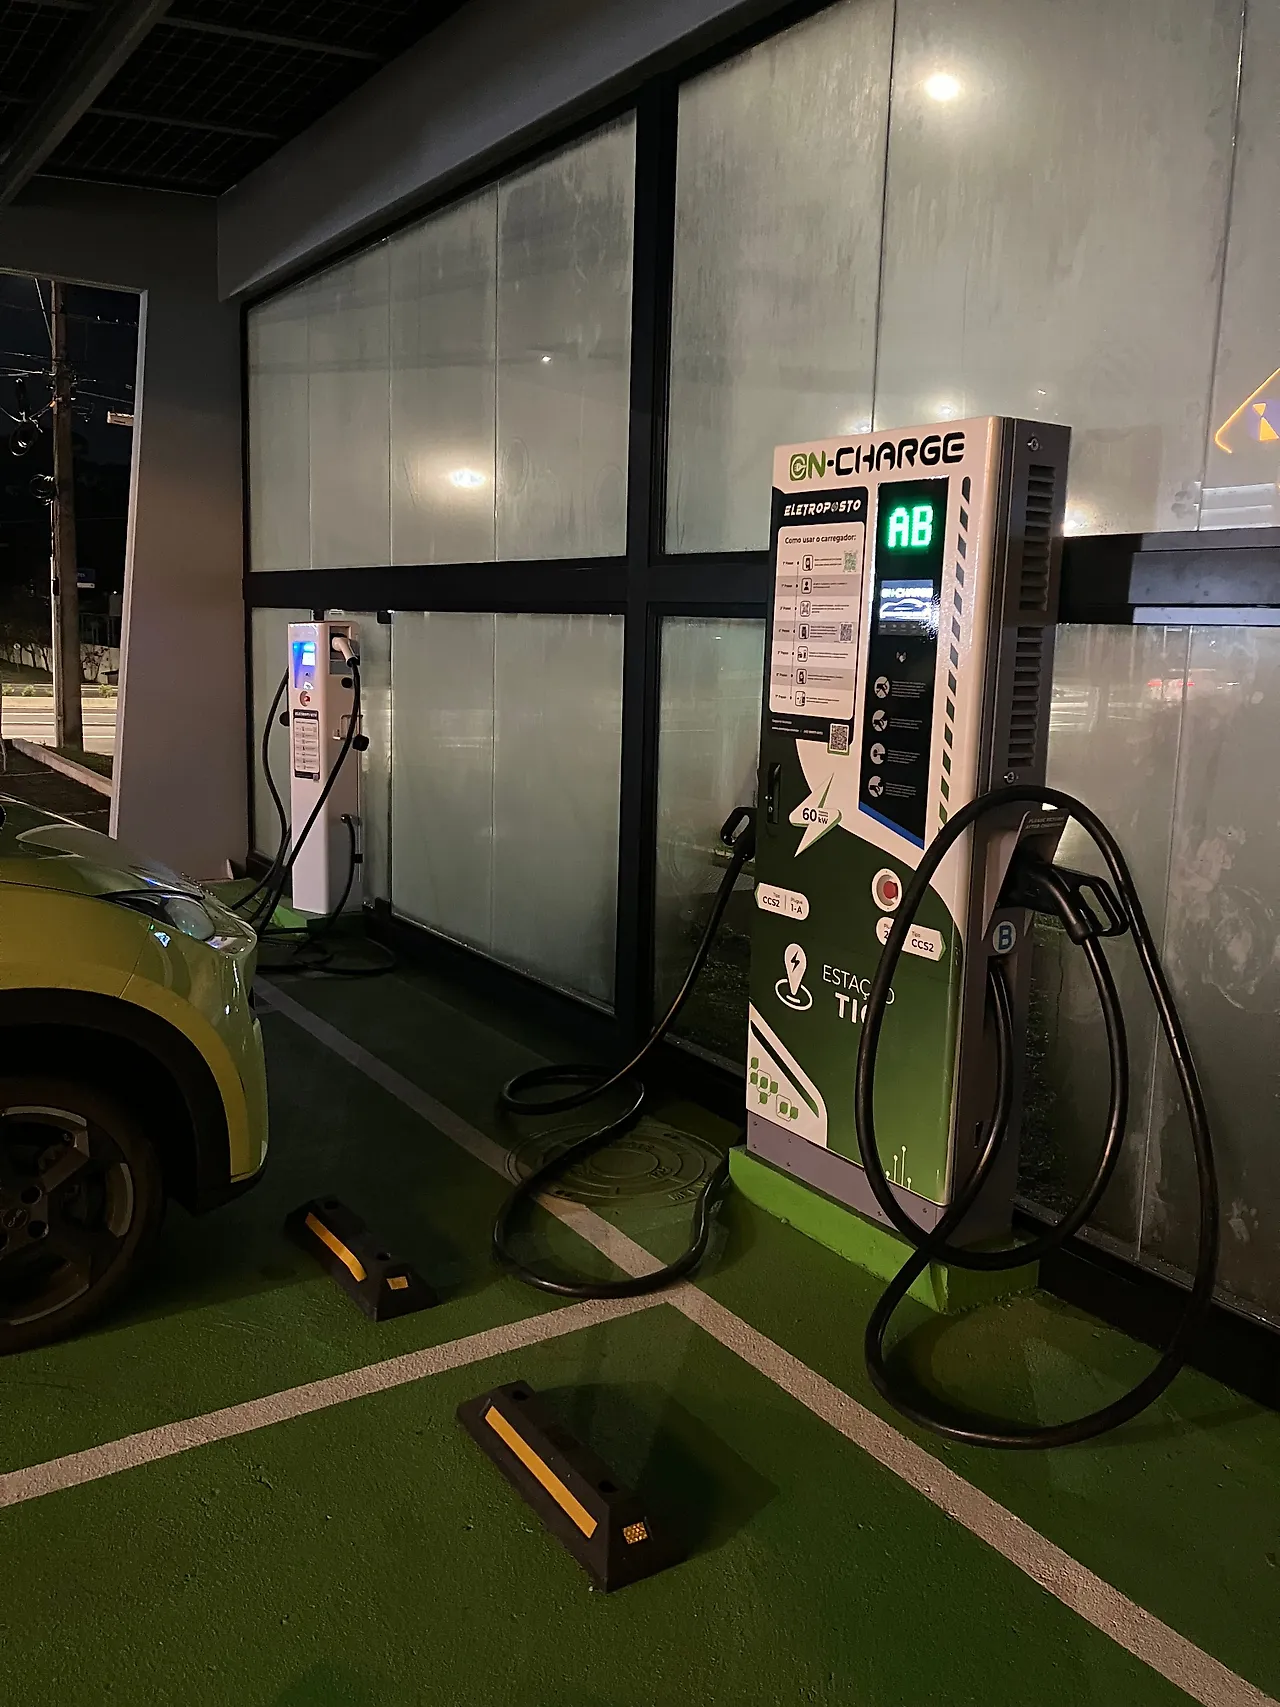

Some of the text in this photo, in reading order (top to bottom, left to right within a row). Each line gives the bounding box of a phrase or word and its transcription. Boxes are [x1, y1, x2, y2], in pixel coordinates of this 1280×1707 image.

[789, 431, 966, 482] ON-CHARGE
[783, 499, 862, 517] ELETROPOSTO
[887, 504, 934, 548] AB
[784, 536, 801, 544] Como
[821, 533, 857, 543] carregador:
[802, 807, 829, 825] 60 kW
[762, 896, 803, 914] CCS2 1-A
[911, 938, 934, 952] CCS2
[998, 925, 1012, 950] B
